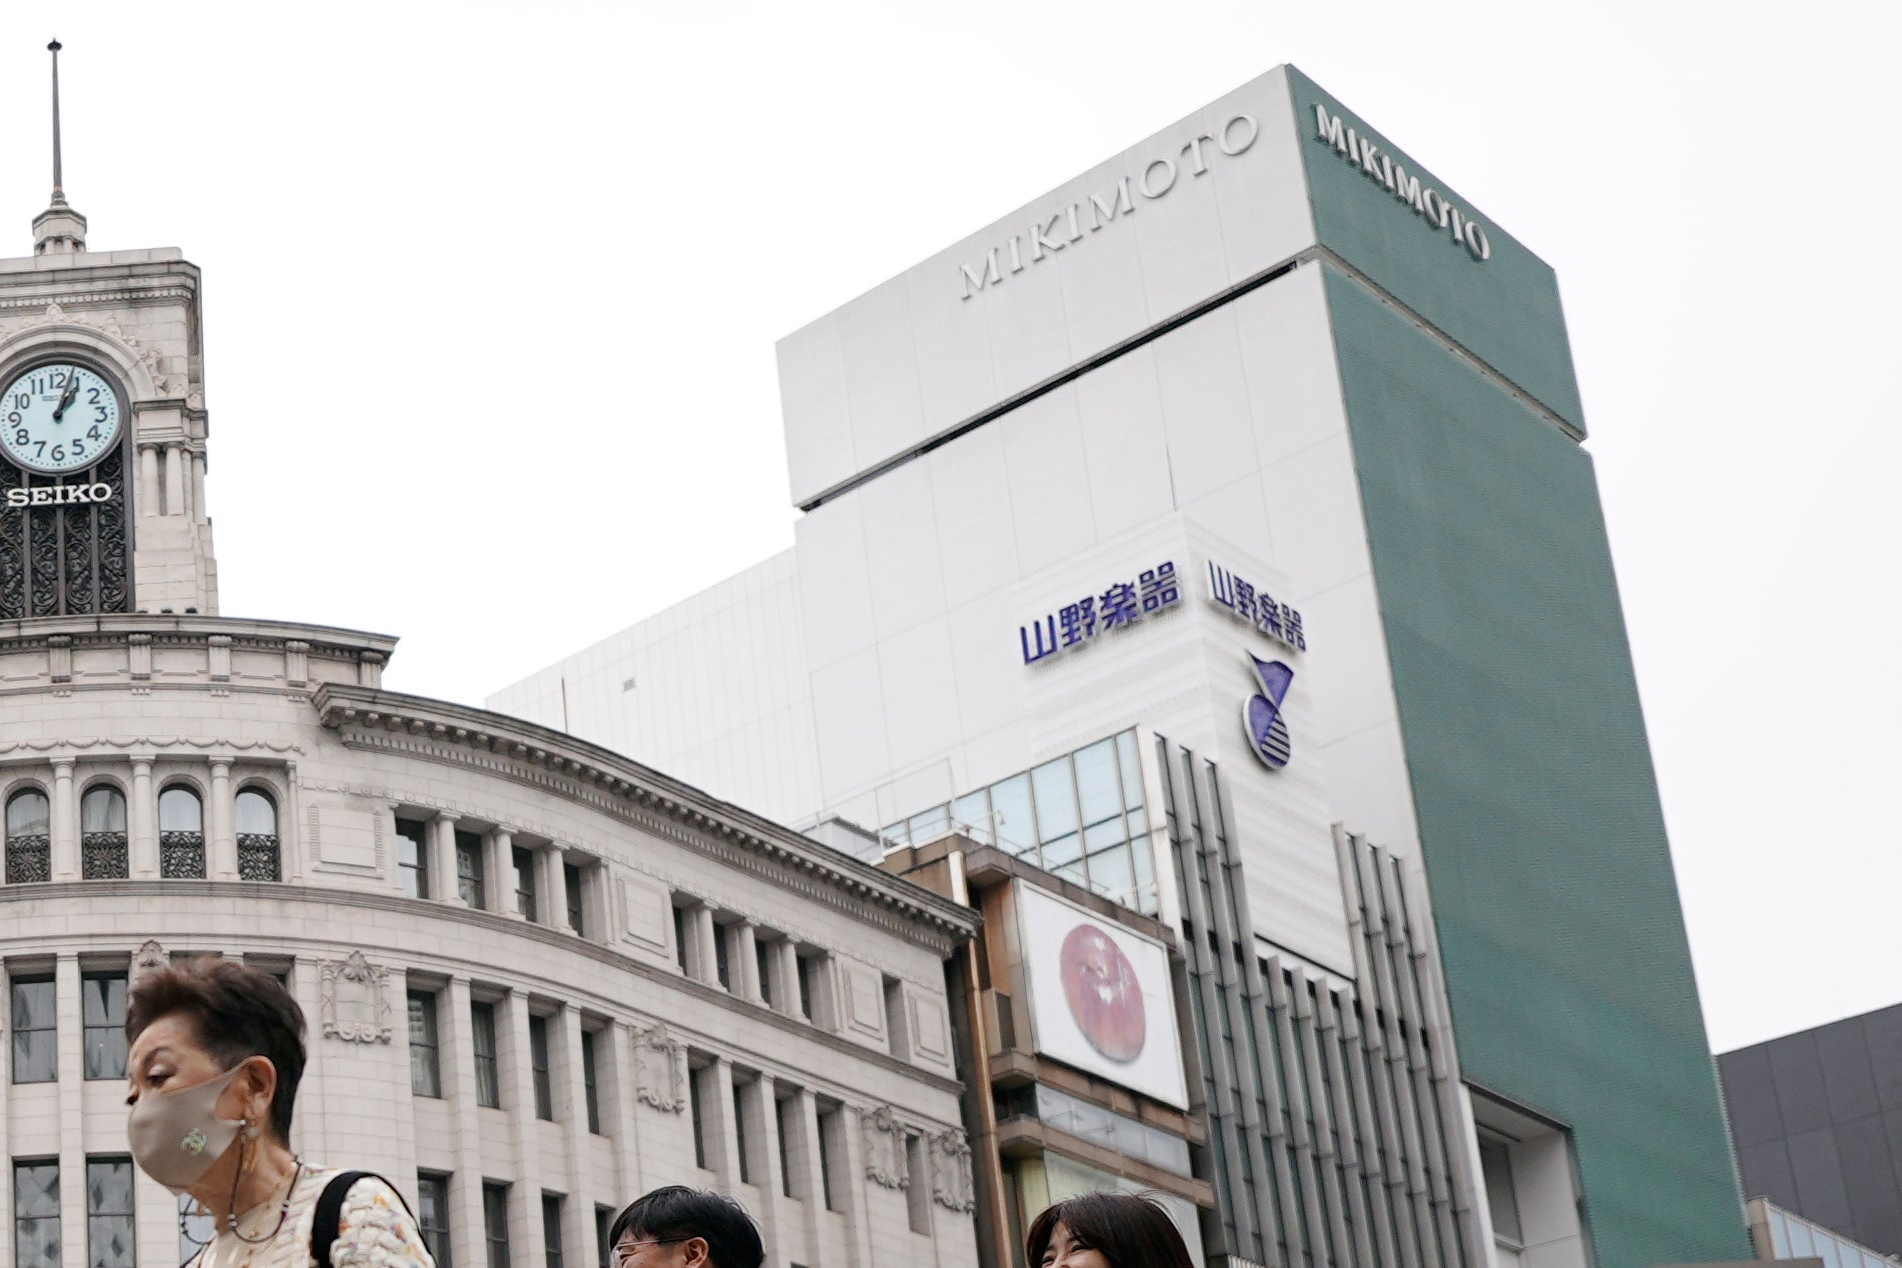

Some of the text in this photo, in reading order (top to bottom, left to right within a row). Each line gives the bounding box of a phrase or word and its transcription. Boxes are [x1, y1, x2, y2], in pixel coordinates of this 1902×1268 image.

[1314, 103, 1491, 262] MIKIMOTO
[959, 112, 1260, 302] MIKIMOTO
[31, 378, 44, 395] 11
[49, 373, 66, 389] 12
[14, 393, 30, 410] 10
[87, 388, 100, 405] 2
[8, 411, 22, 429] 9
[95, 406, 108, 423] 3
[15, 428, 30, 446] 8
[86, 425, 102, 442] 4
[33, 441, 48, 458] 7
[51, 444, 66, 462] 6
[72, 438, 85, 455] 5
[7, 482, 112, 508] SEIKO
[1019, 559, 1182, 666] 山野楽器
[1206, 559, 1307, 653] 山野楽器
